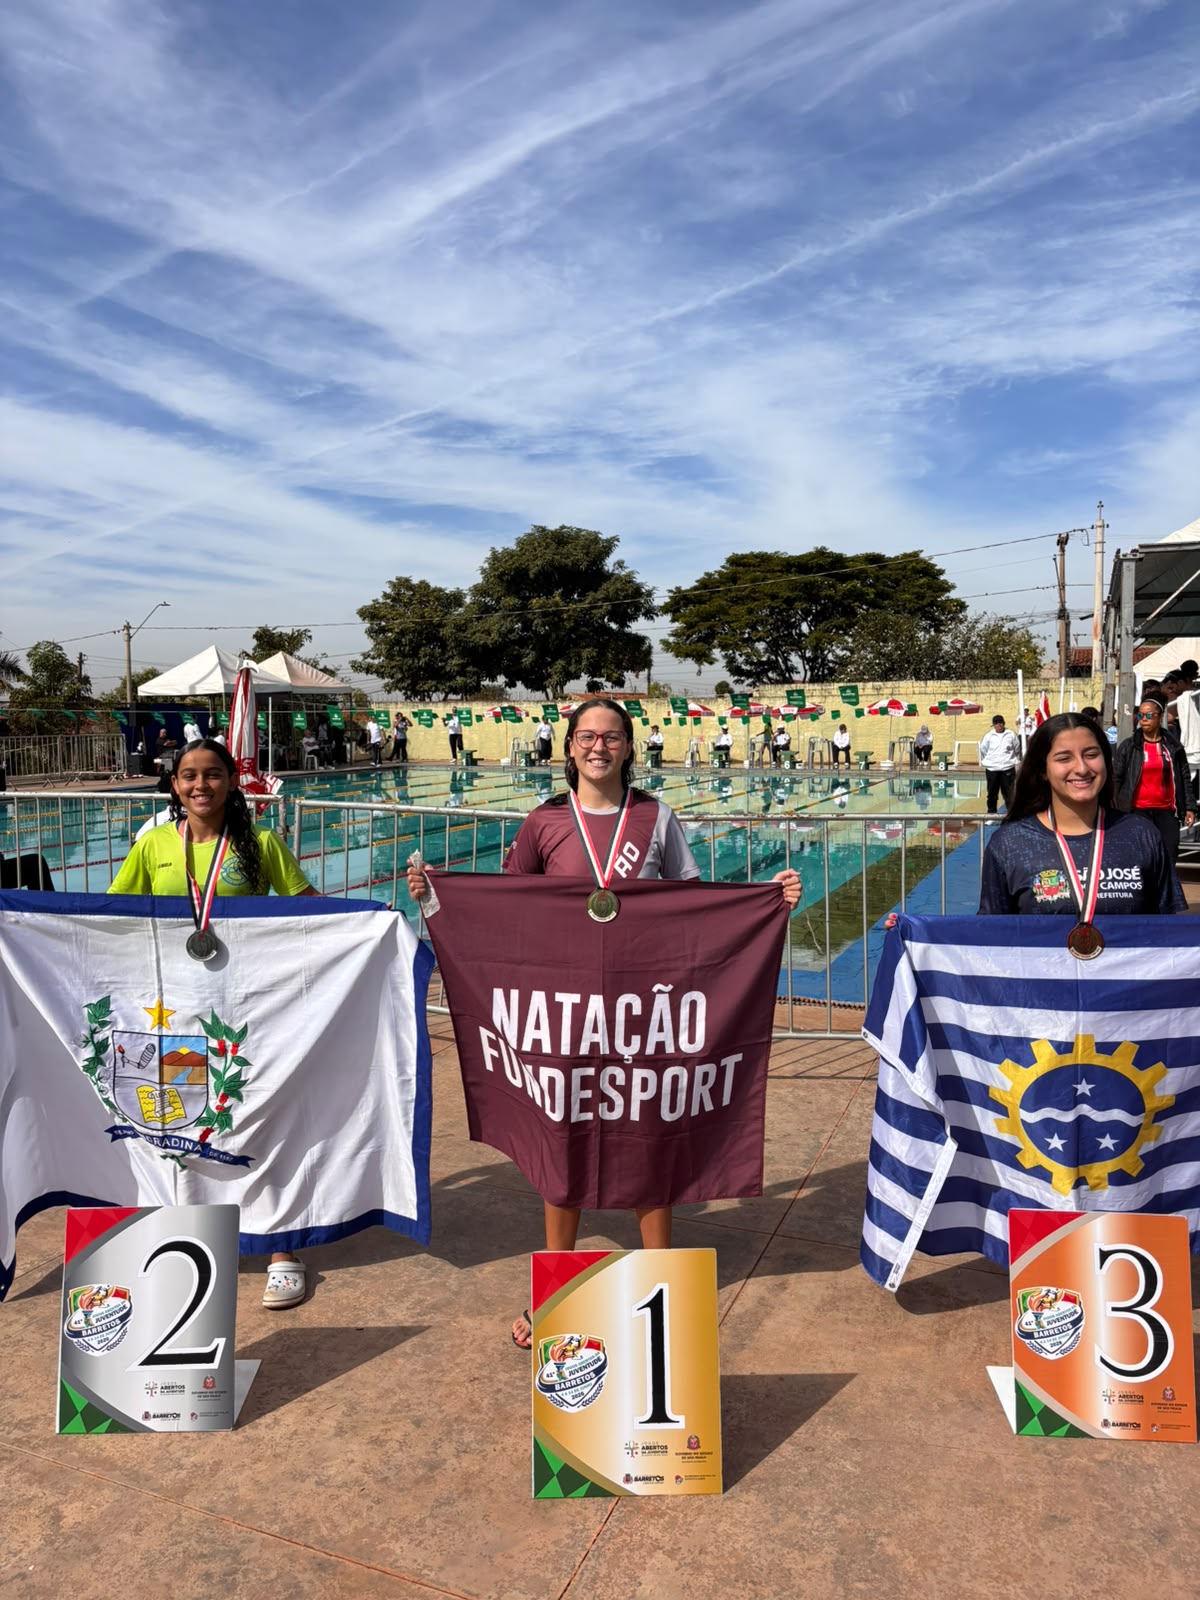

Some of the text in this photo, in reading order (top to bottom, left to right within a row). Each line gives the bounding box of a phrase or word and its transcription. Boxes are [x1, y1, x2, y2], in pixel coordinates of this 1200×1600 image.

[520, 758, 526, 767] 2
[713, 758, 720, 768] 5
[784, 759, 791, 769] 6
[859, 761, 865, 770] 7
[938, 761, 946, 771] 8
[1106, 865, 1141, 880] JOSÉ
[1099, 881, 1142, 890] CAMPOS
[492, 983, 707, 1064] NATAÇÃO
[478, 1025, 744, 1123] FUNDESPORT
[134, 1238, 223, 1369] 2
[1097, 1245, 1171, 1380] 3
[95, 1304, 128, 1324] JUVENTUDE
[1046, 1309, 1080, 1327] JUVENTUDE
[81, 1318, 121, 1337] BARRETOS
[1033, 1323, 1073, 1339] BARRETOS
[635, 1285, 682, 1427] 1
[568, 1357, 603, 1377] JUVENTUDE
[554, 1371, 597, 1391] BARRETOS
